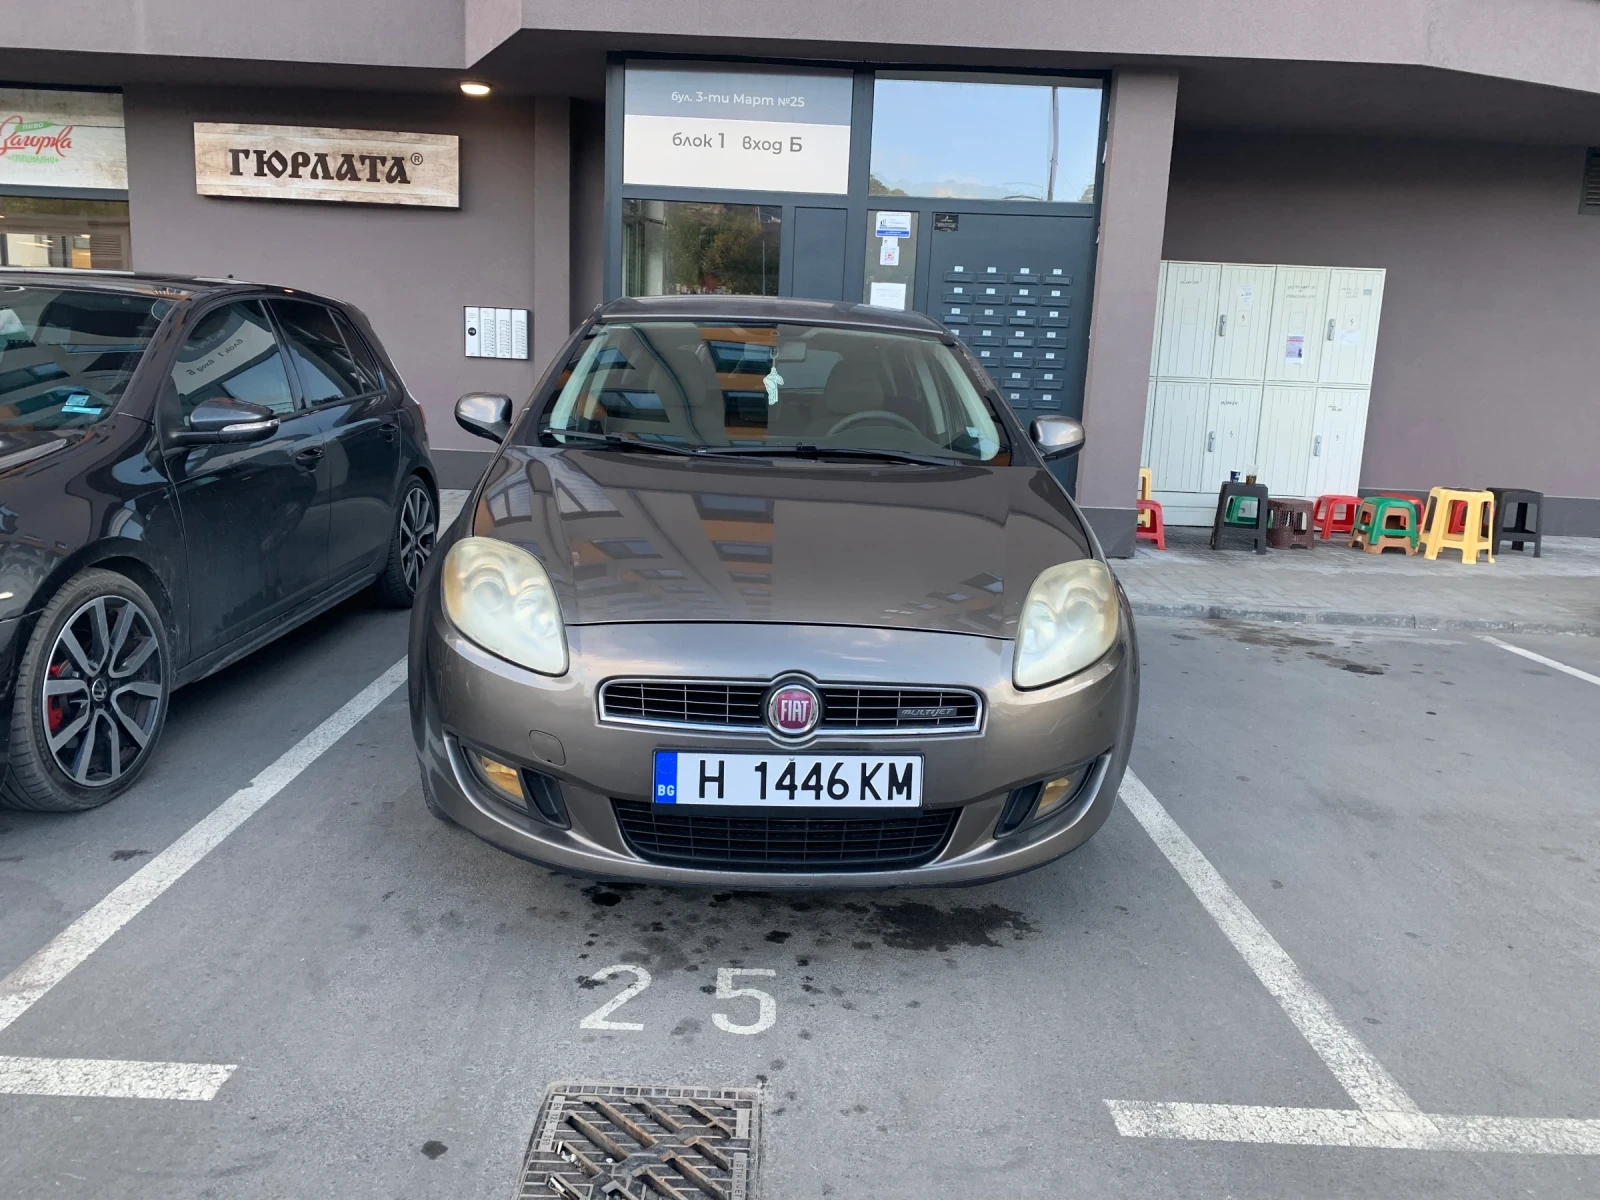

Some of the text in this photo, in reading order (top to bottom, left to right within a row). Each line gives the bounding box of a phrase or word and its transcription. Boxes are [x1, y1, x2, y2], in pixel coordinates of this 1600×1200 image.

[671, 91, 805, 107] бул. 3-ти Март №25
[672, 132, 803, 155] блок 1 вход Б
[780, 699, 809, 723] FIAT
[901, 708, 954, 717] MULTIJET
[657, 784, 675, 797] BG
